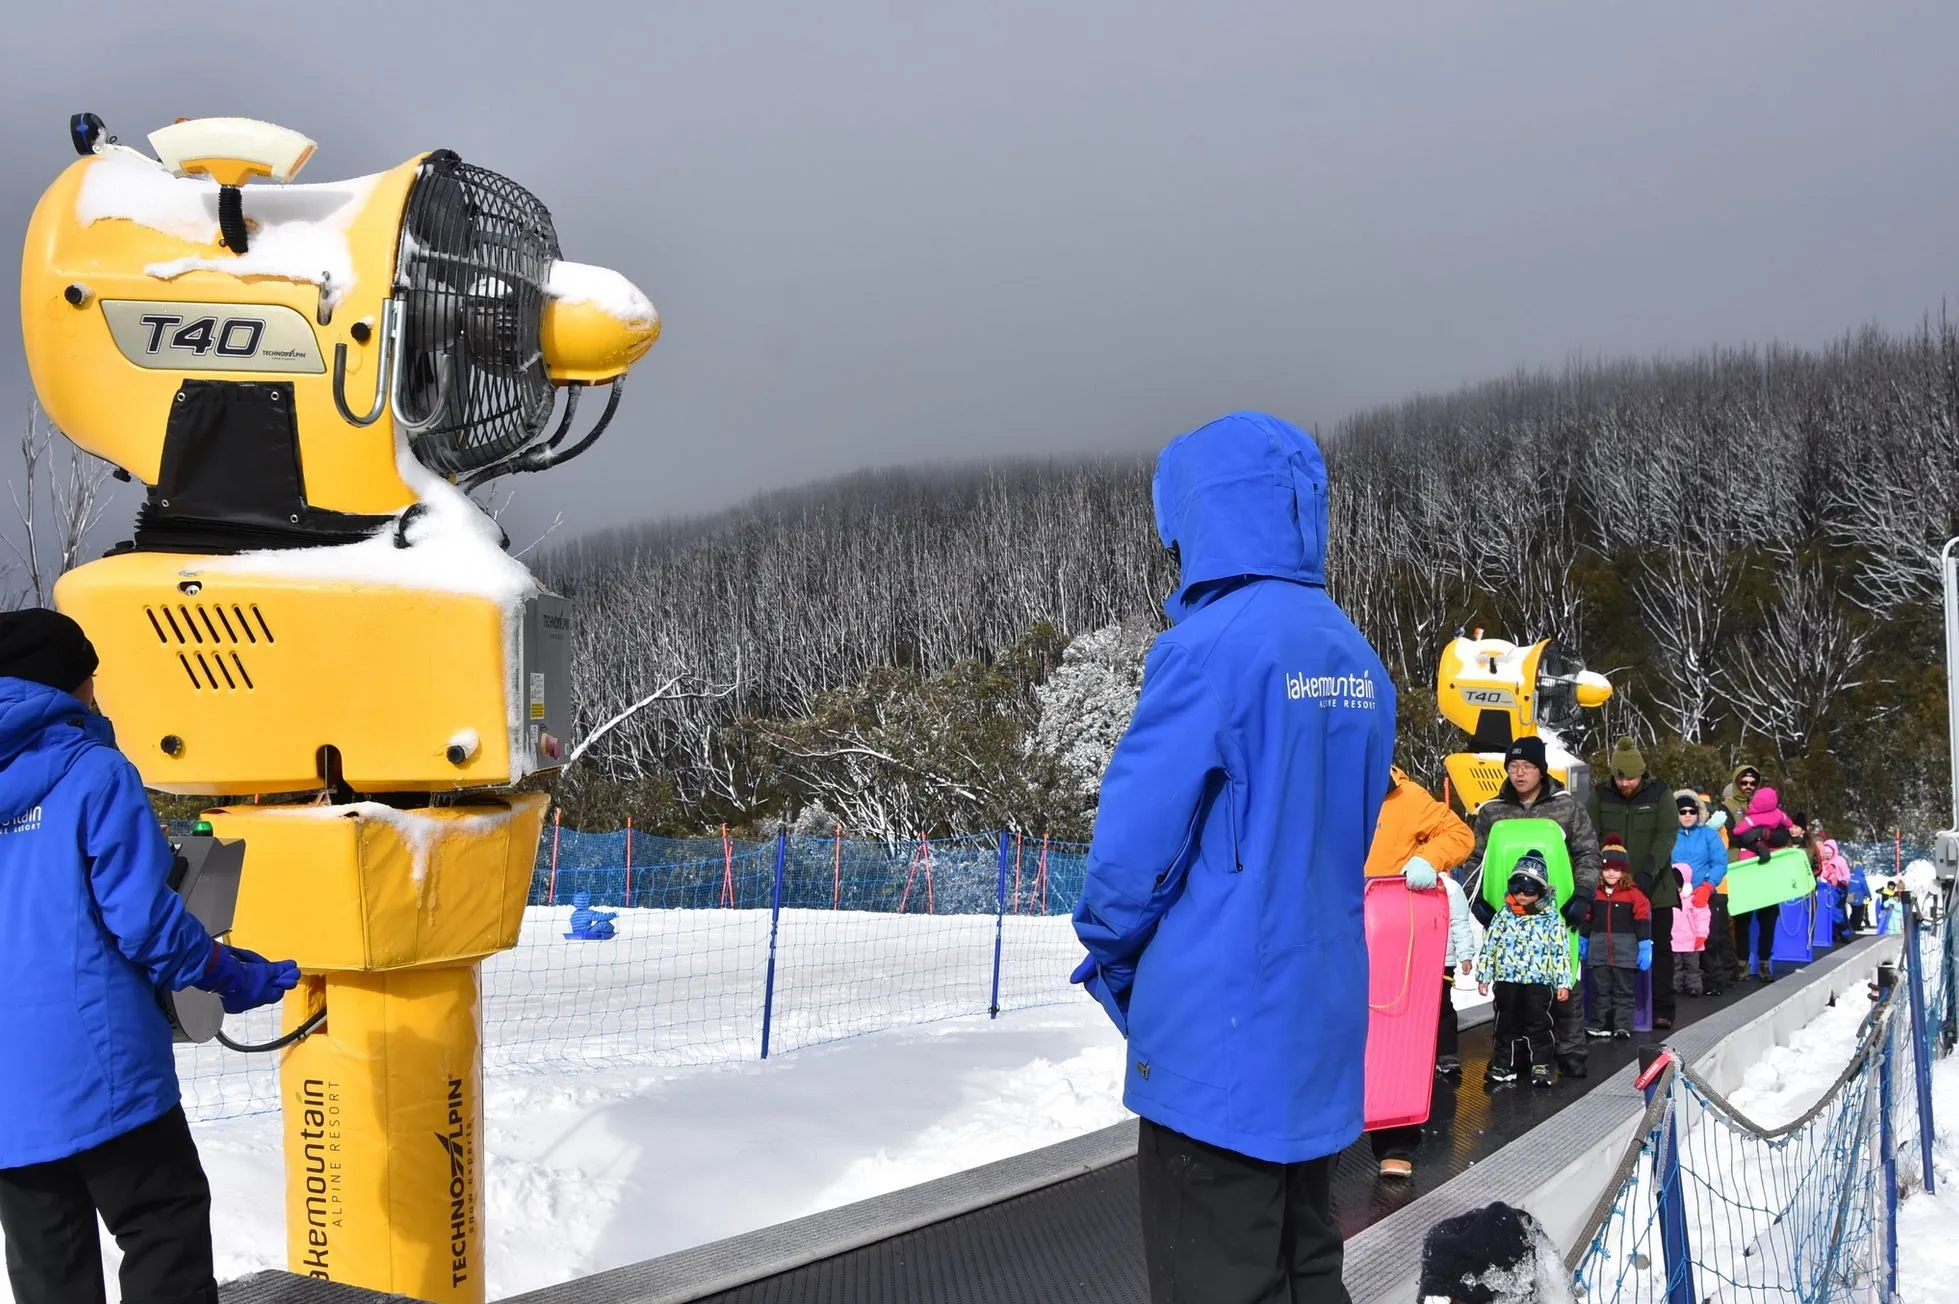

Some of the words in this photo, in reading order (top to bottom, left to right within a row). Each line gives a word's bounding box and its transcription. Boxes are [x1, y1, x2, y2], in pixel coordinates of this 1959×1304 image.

[140, 314, 266, 358] T40
[1466, 691, 1501, 702] T40
[328, 1081, 340, 1151] RESORT
[296, 1079, 330, 1281] akemountain
[330, 1162, 343, 1227] ALPINE
[435, 1078, 467, 1288] TECHNOALPIN
